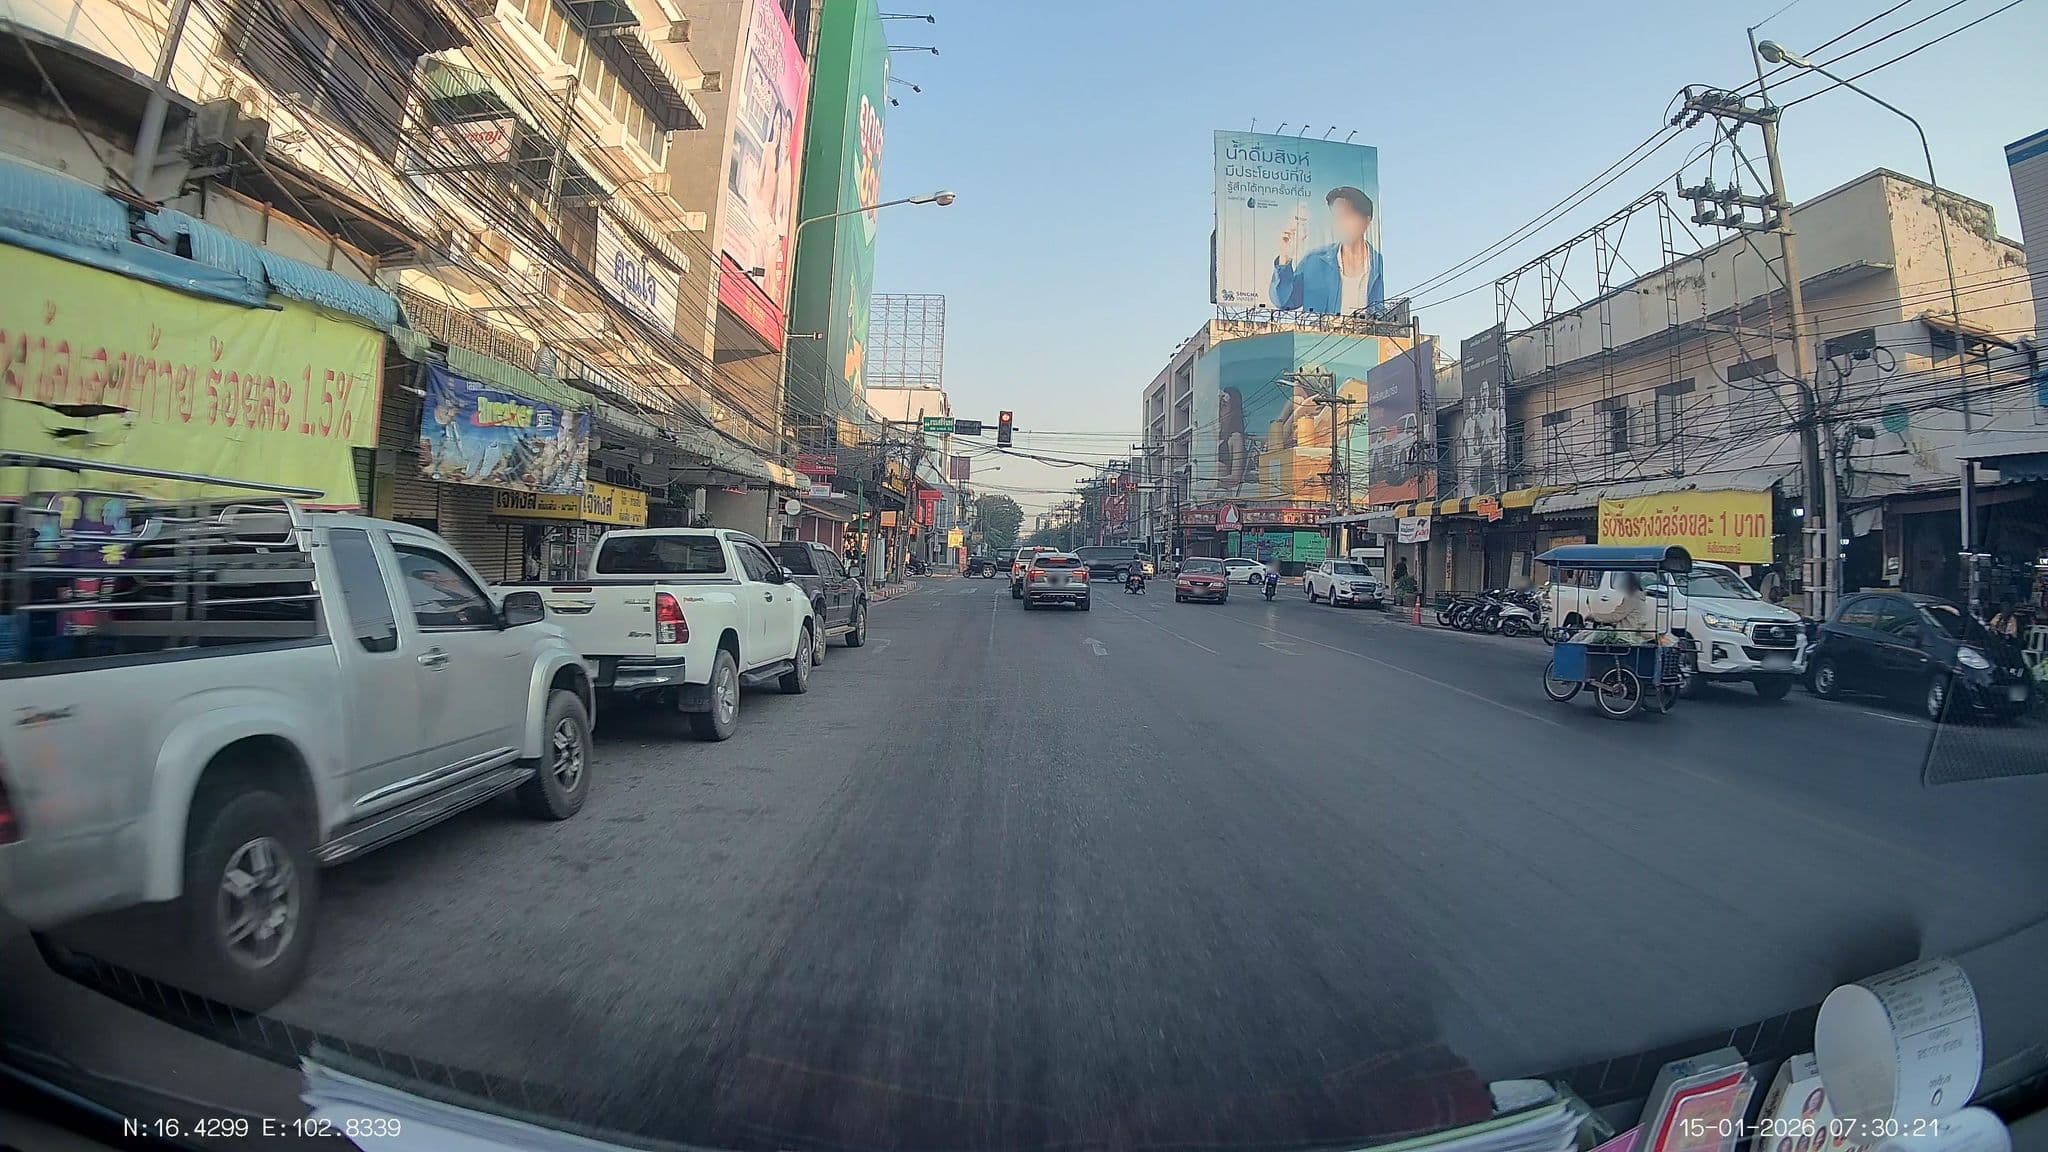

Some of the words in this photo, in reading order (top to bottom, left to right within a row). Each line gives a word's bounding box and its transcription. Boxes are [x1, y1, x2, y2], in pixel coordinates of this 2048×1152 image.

[1226, 140, 1309, 166] น้ำดื่มสิงห์
[1226, 165, 1311, 183] มีประโยชน์ที่ใช่
[206, 335, 292, 432] ร้อยละ
[299, 363, 353, 439] 1.5%
[1602, 503, 1714, 537] รับซื้อรางวัลร้อยละ
[1719, 511, 1727, 536] 1
[1734, 513, 1766, 538] บาท
